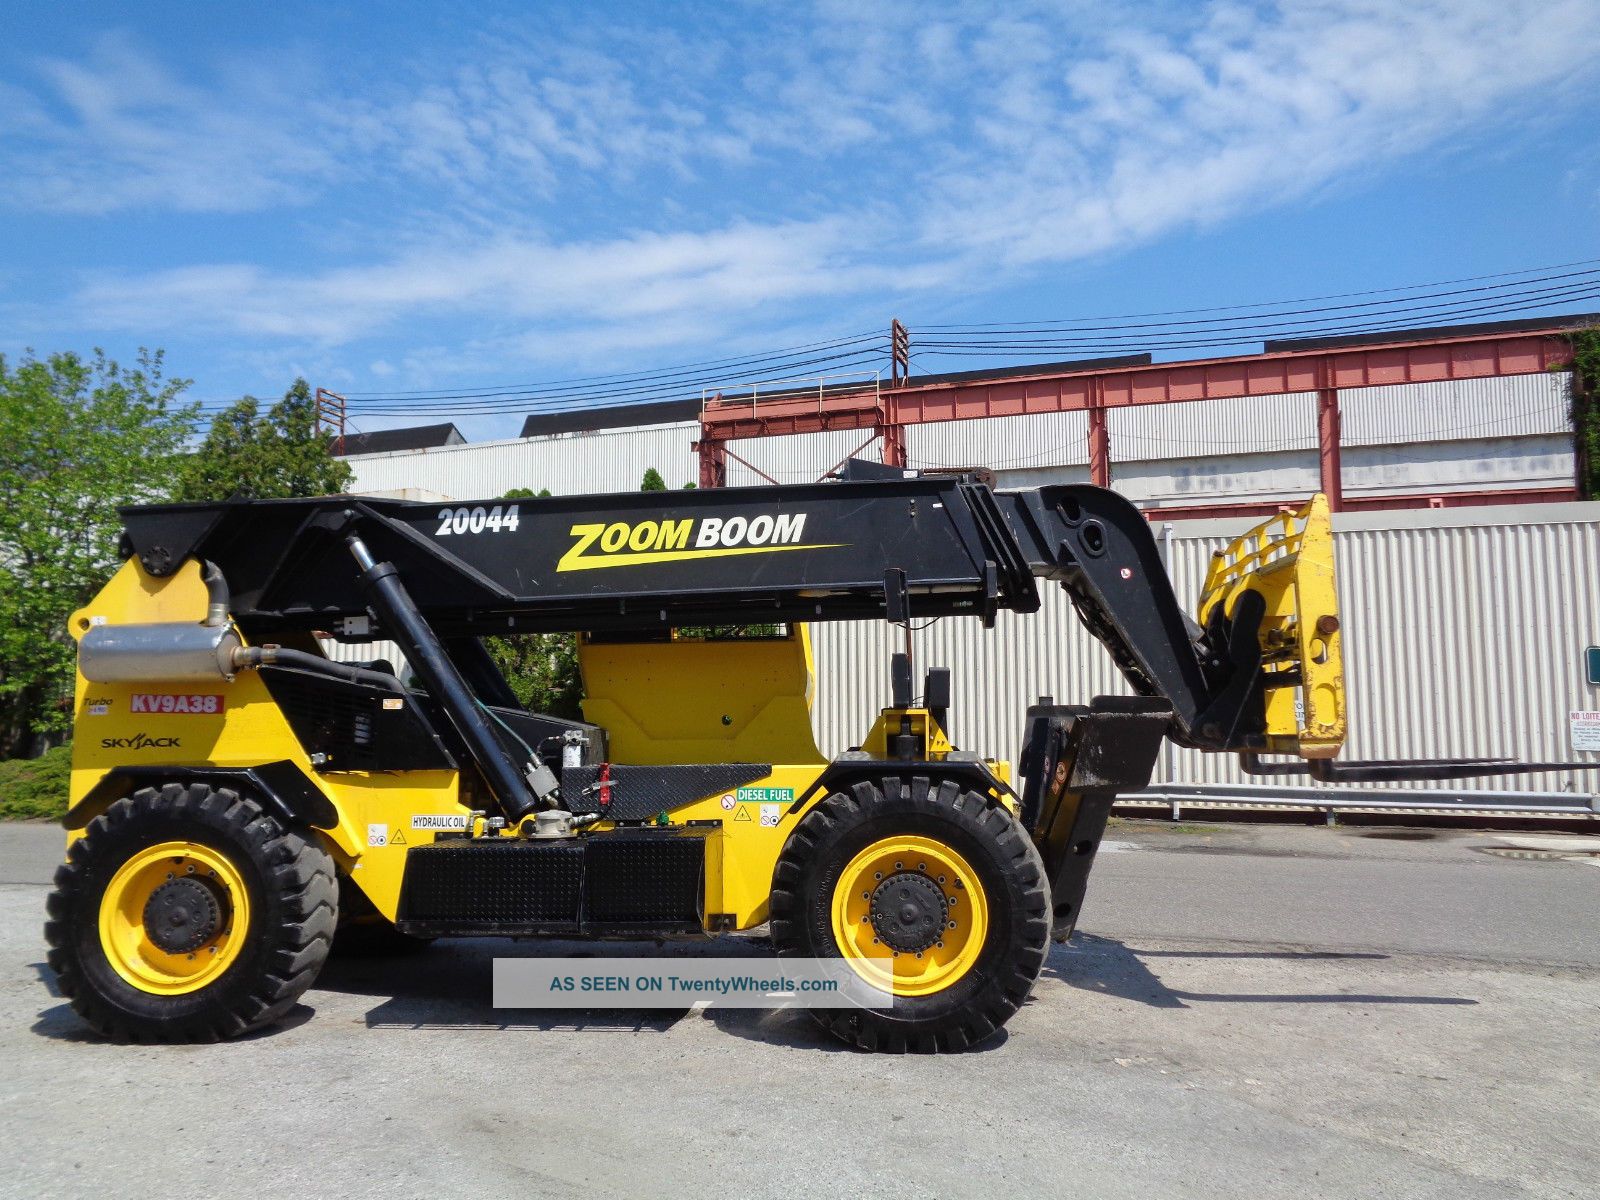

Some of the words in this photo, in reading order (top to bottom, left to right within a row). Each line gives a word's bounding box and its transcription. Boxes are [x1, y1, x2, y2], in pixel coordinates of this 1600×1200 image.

[435, 504, 519, 536] 20044
[556, 519, 694, 572] ZOOM
[695, 513, 807, 548] BOOM
[83, 696, 114, 706] Turbo
[132, 694, 217, 713] KV9A38
[1571, 712, 1580, 720] NO
[101, 733, 181, 750] SKYJACK
[738, 789, 768, 801] DIESEL
[769, 789, 792, 801] FUEL
[413, 817, 452, 827] HYDRAULIC
[453, 817, 465, 827] OIL
